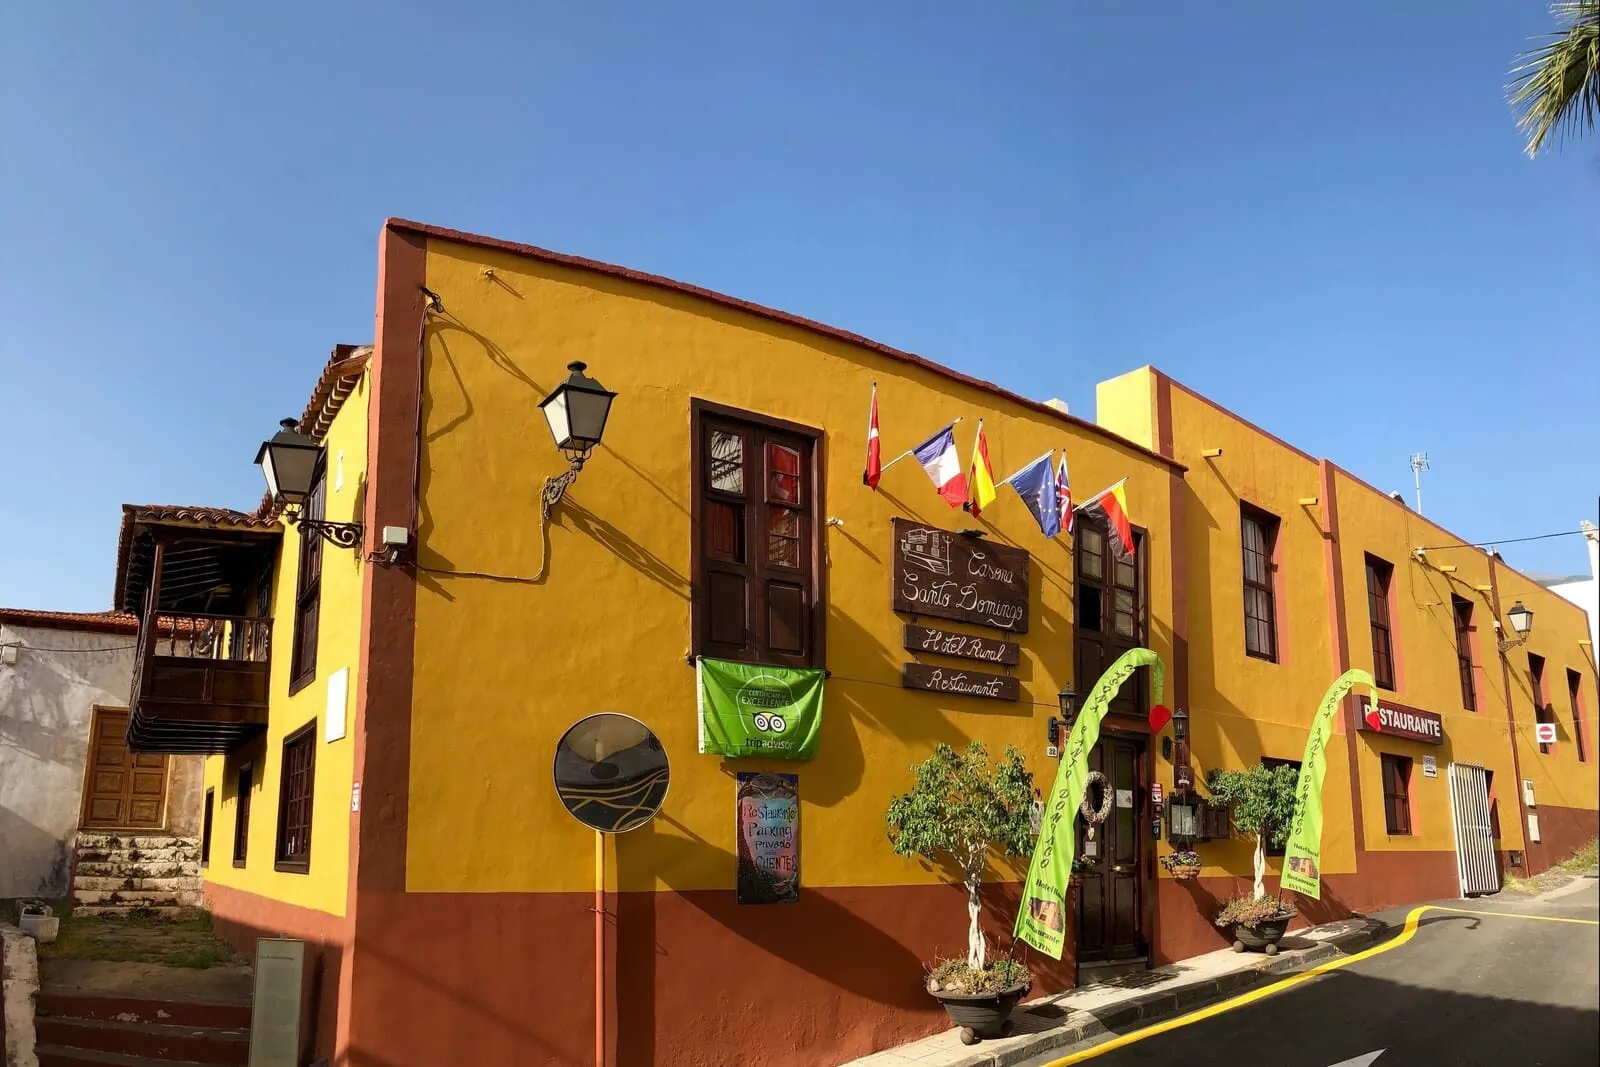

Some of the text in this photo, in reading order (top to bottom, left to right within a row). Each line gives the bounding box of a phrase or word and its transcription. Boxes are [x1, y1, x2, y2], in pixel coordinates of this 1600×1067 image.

[967, 548, 1013, 584] Casona
[902, 569, 1023, 628] Santo Domingo
[922, 629, 1006, 662] Hotel Rural
[926, 668, 1003, 697] Restaurante
[1090, 664, 1135, 713] CASONA
[741, 696, 790, 707] EXCELLENCE
[1364, 704, 1441, 737] RSTAURANTE
[745, 737, 795, 752] tripadvisor
[1065, 725, 1087, 779] SANTO
[1040, 788, 1069, 869] DOMINGO
